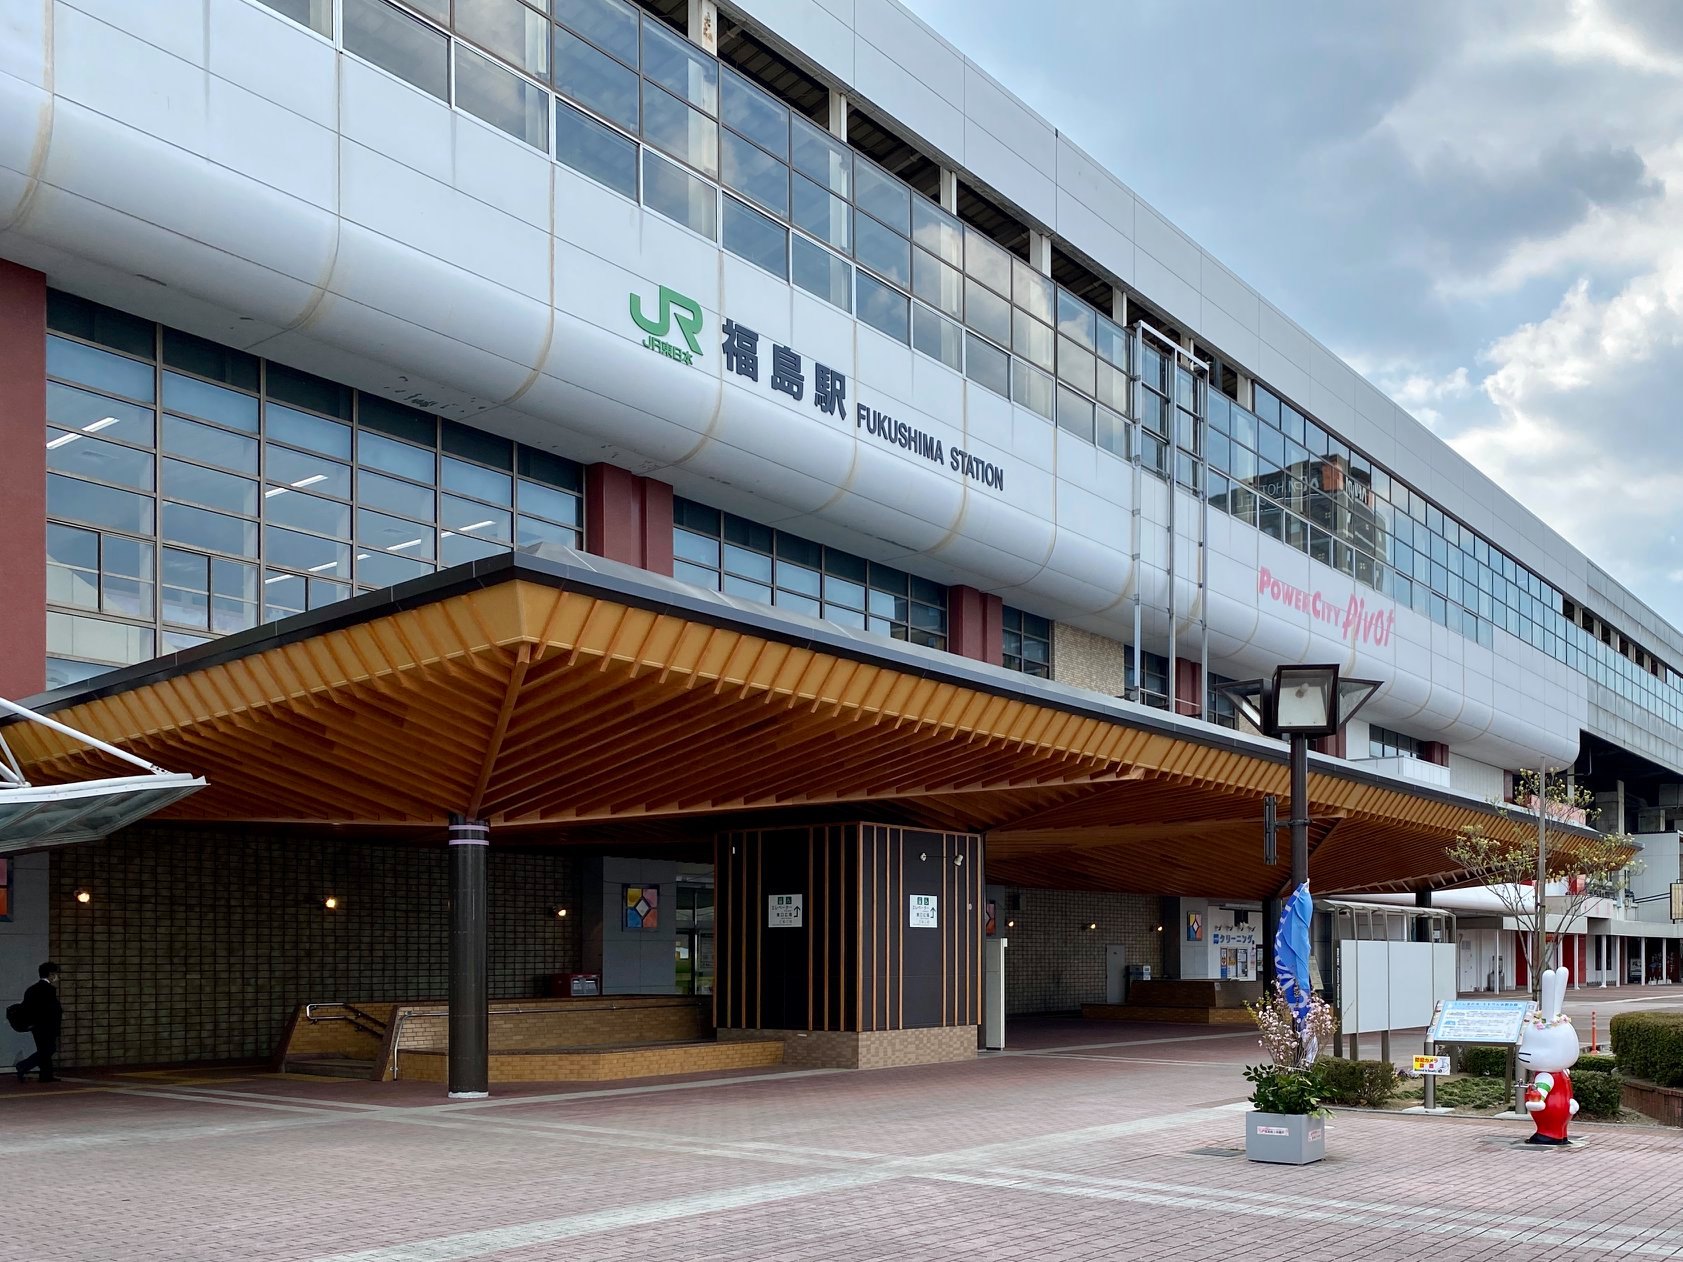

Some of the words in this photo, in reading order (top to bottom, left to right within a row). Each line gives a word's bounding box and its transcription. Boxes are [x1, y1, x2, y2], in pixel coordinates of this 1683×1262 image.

[629, 285, 704, 356] JR
[642, 335, 693, 366] JR東日本
[721, 318, 847, 421] 福島駅
[856, 402, 944, 465] FUKUSHIMA
[950, 446, 1004, 491] STATION
[1220, 934, 1253, 944] クリーニング
